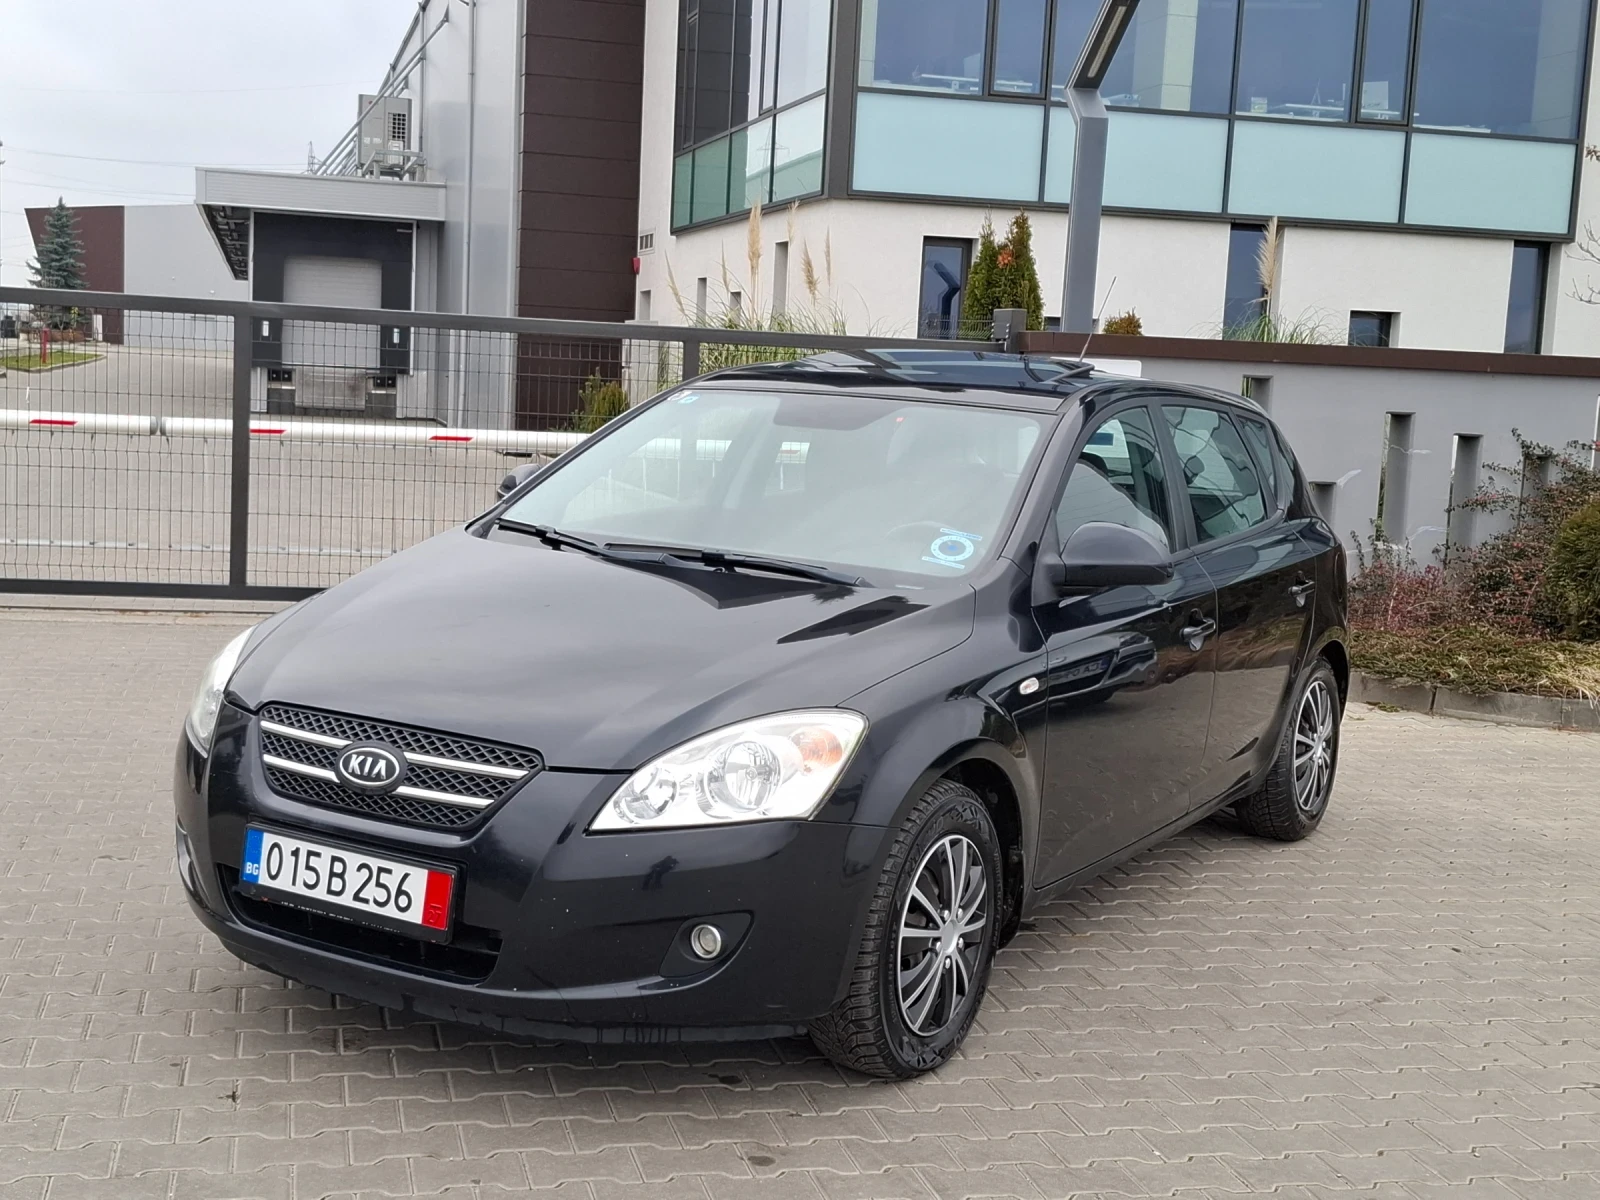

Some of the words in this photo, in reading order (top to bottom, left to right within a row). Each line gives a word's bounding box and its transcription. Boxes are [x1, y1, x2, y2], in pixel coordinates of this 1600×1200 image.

[348, 753, 387, 780] KIA
[245, 862, 260, 876] BG
[266, 841, 413, 913] 015B256
